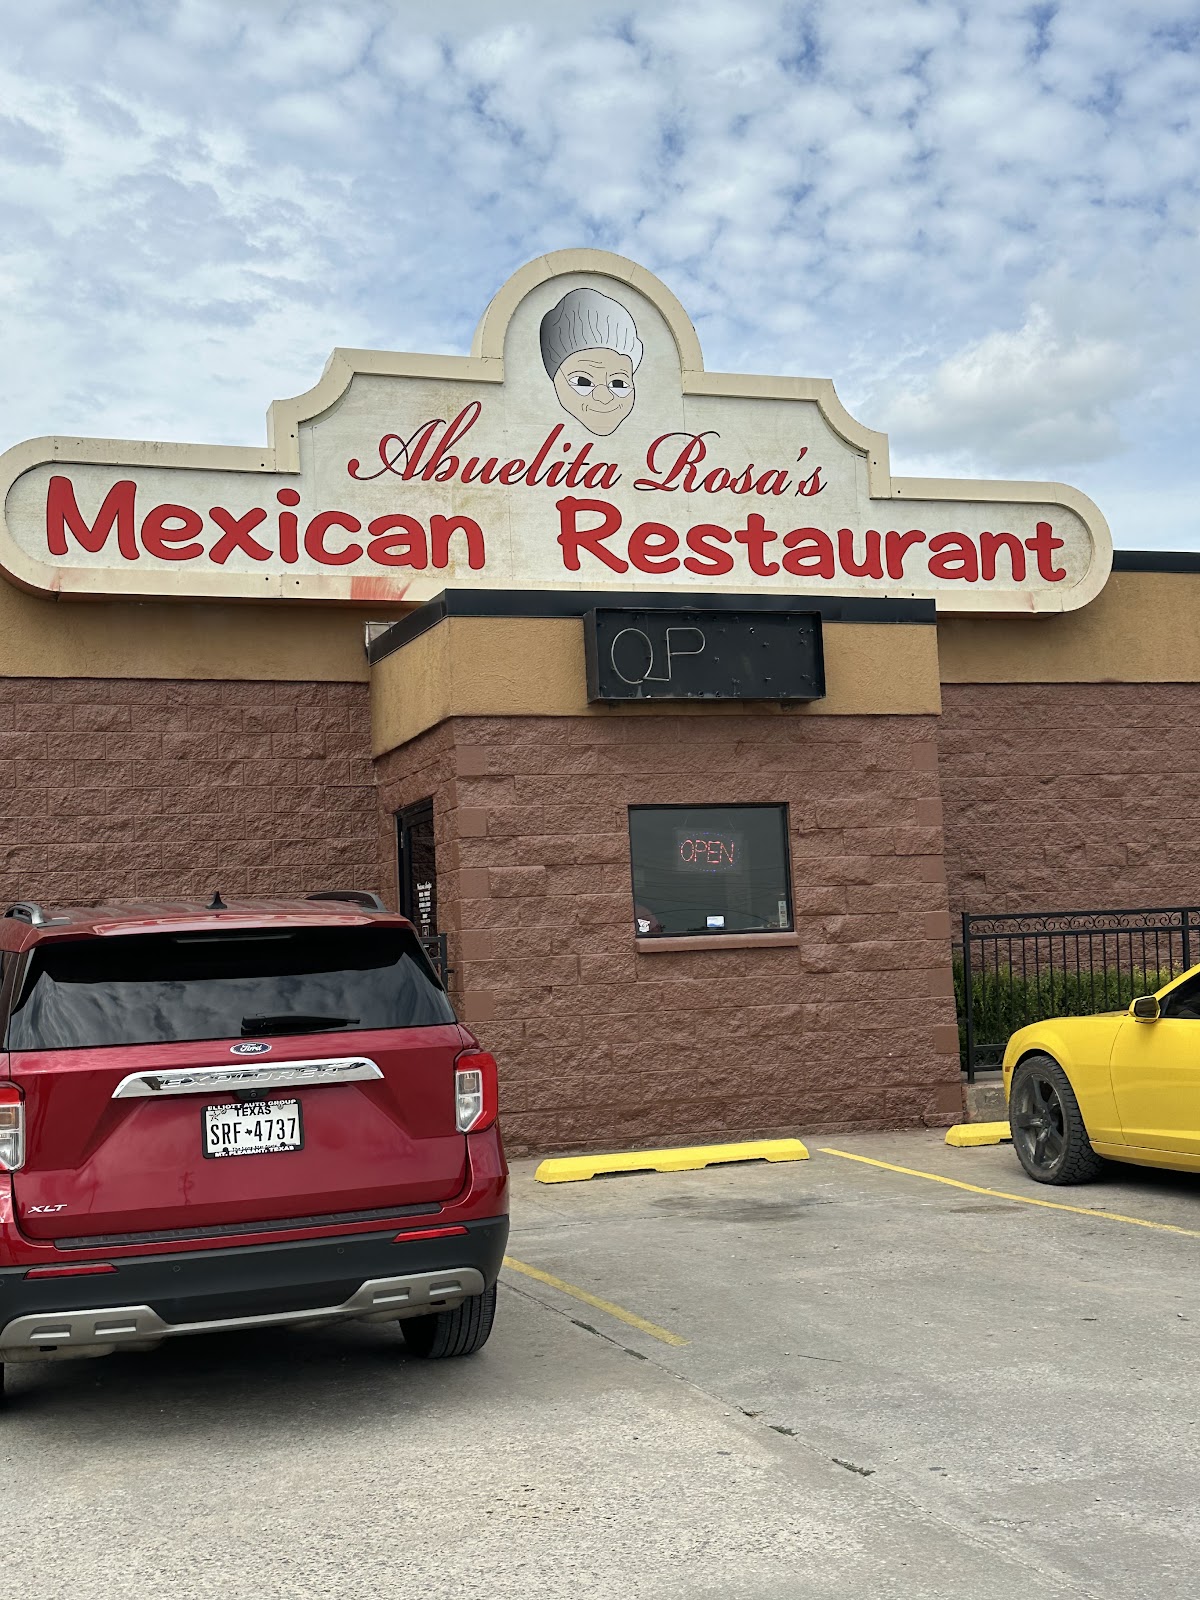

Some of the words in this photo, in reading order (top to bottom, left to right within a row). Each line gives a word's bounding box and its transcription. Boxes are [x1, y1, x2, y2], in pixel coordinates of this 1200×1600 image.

[348, 401, 622, 490] Abuelita
[633, 430, 828, 497] Rosa's
[46, 475, 485, 570] Mexican
[556, 495, 1067, 583] Restaurant
[680, 839, 735, 864] OPEN
[160, 1066, 338, 1089] EXPLORER
[234, 1107, 272, 1117] TEXAS
[210, 1122, 242, 1145] SRF
[254, 1117, 296, 1142] 4737
[268, 1145, 295, 1153] TEXAS
[27, 1204, 68, 1214] XLT
